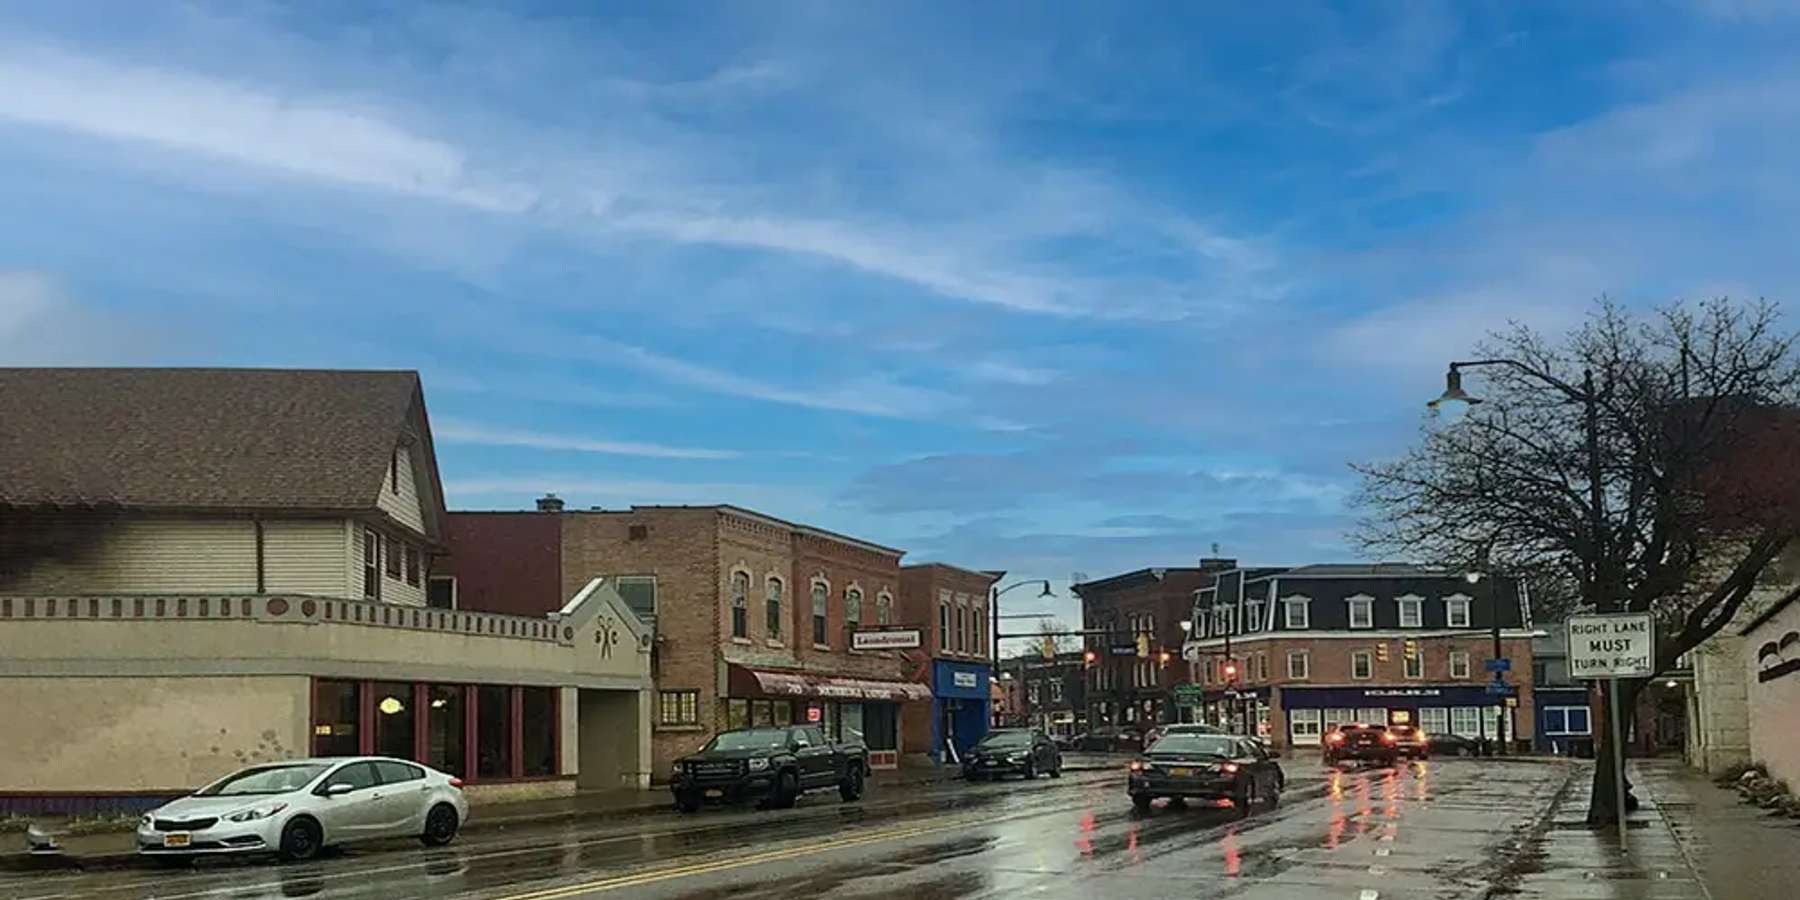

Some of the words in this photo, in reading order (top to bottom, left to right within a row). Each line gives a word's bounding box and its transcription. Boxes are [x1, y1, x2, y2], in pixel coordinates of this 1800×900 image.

[1571, 624, 1608, 634] RIGHT
[1614, 621, 1647, 633] LANE
[857, 635, 916, 646] Laundromat
[1590, 639, 1632, 653] MUST
[1574, 658, 1608, 669] TURN
[1614, 656, 1647, 668] RIGHT
